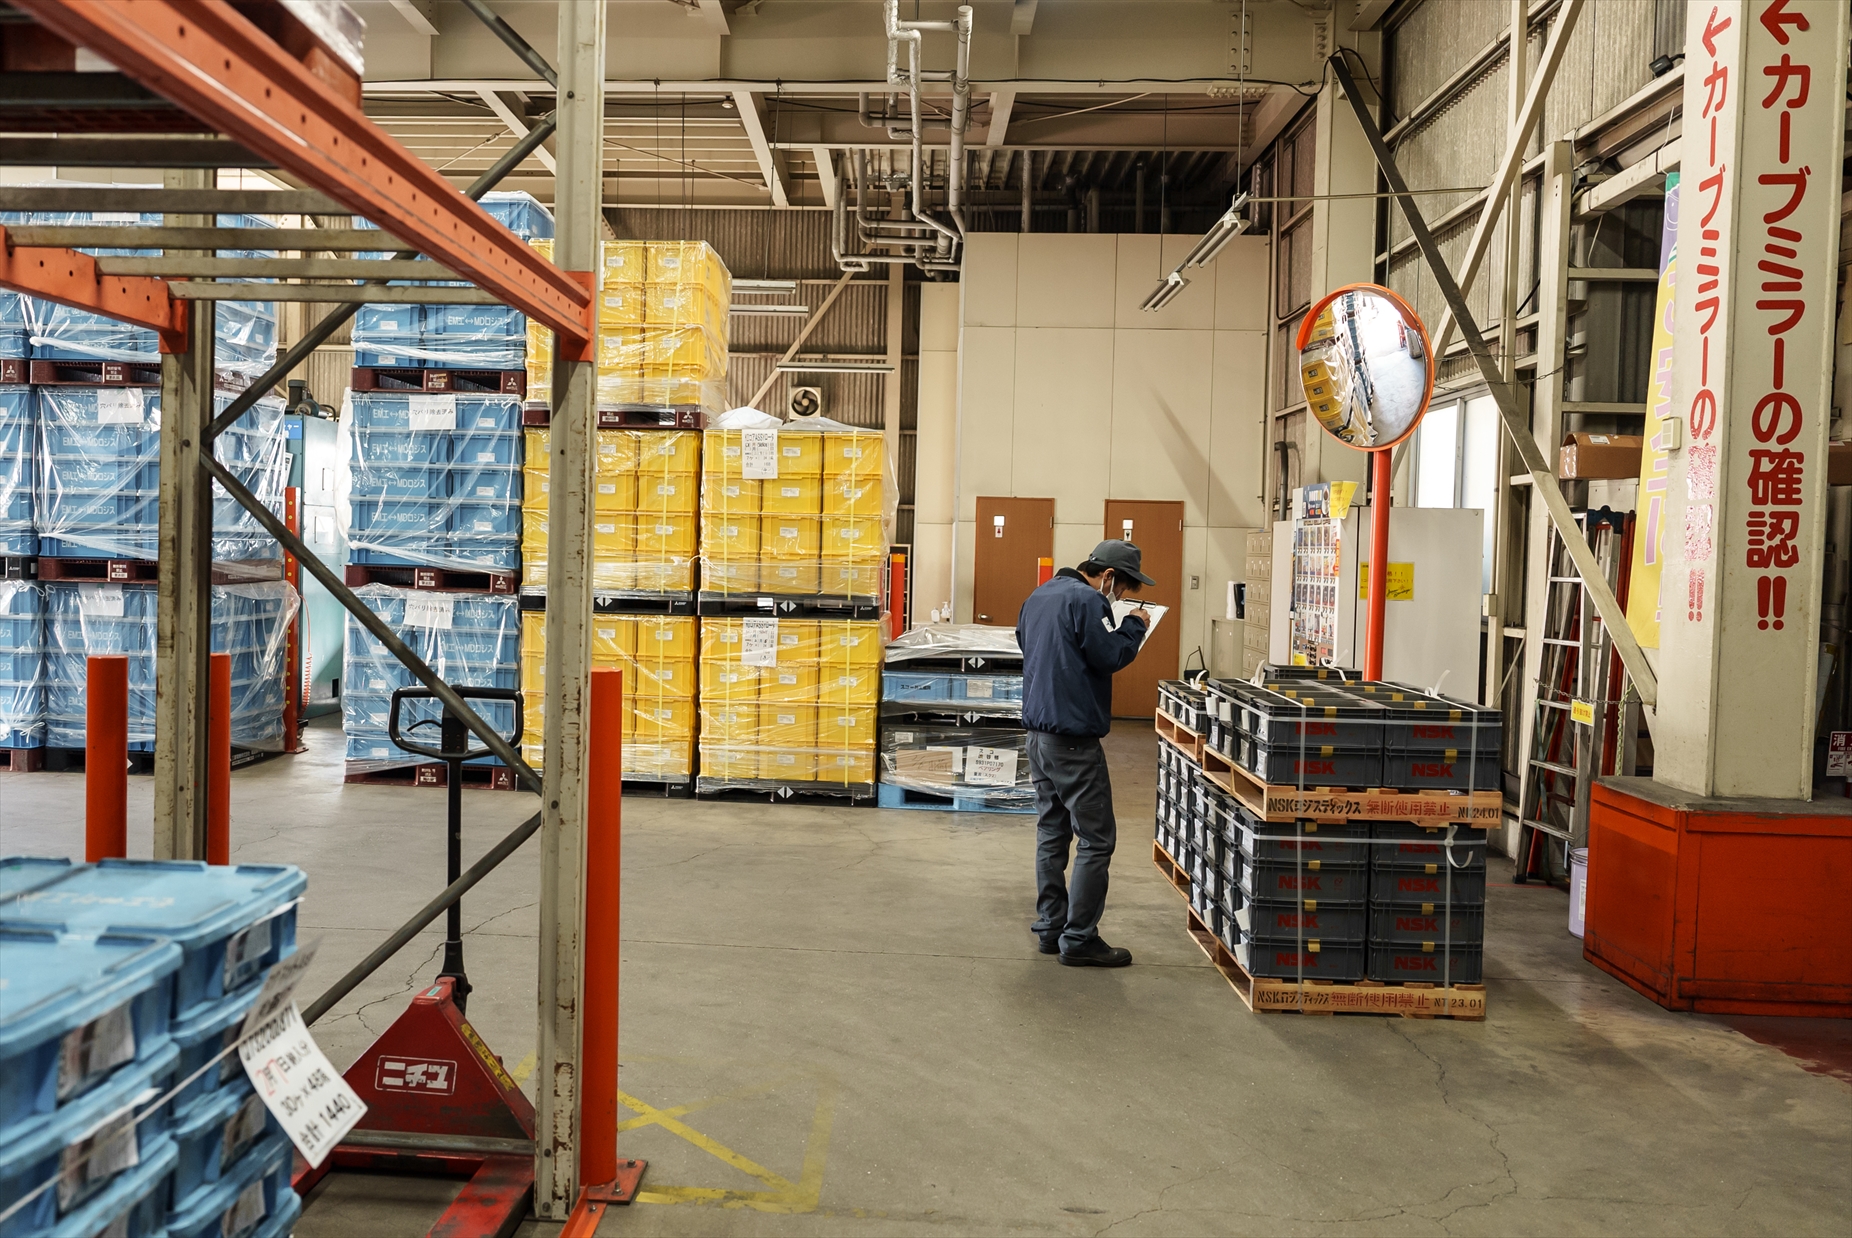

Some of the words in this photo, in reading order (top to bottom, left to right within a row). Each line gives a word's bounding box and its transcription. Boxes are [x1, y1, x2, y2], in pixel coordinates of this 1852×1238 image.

[1412, 763, 1454, 778] NSK
[1366, 799, 1451, 817] 無断使用禁止
[1278, 875, 1322, 890] NSK
[1398, 878, 1440, 893] NSK
[1277, 914, 1319, 928] NSK
[1396, 917, 1439, 932] NSK
[1276, 952, 1318, 967] NSK
[1394, 956, 1437, 971] NSK
[1331, 992, 1430, 1010] 無断使用禁止
